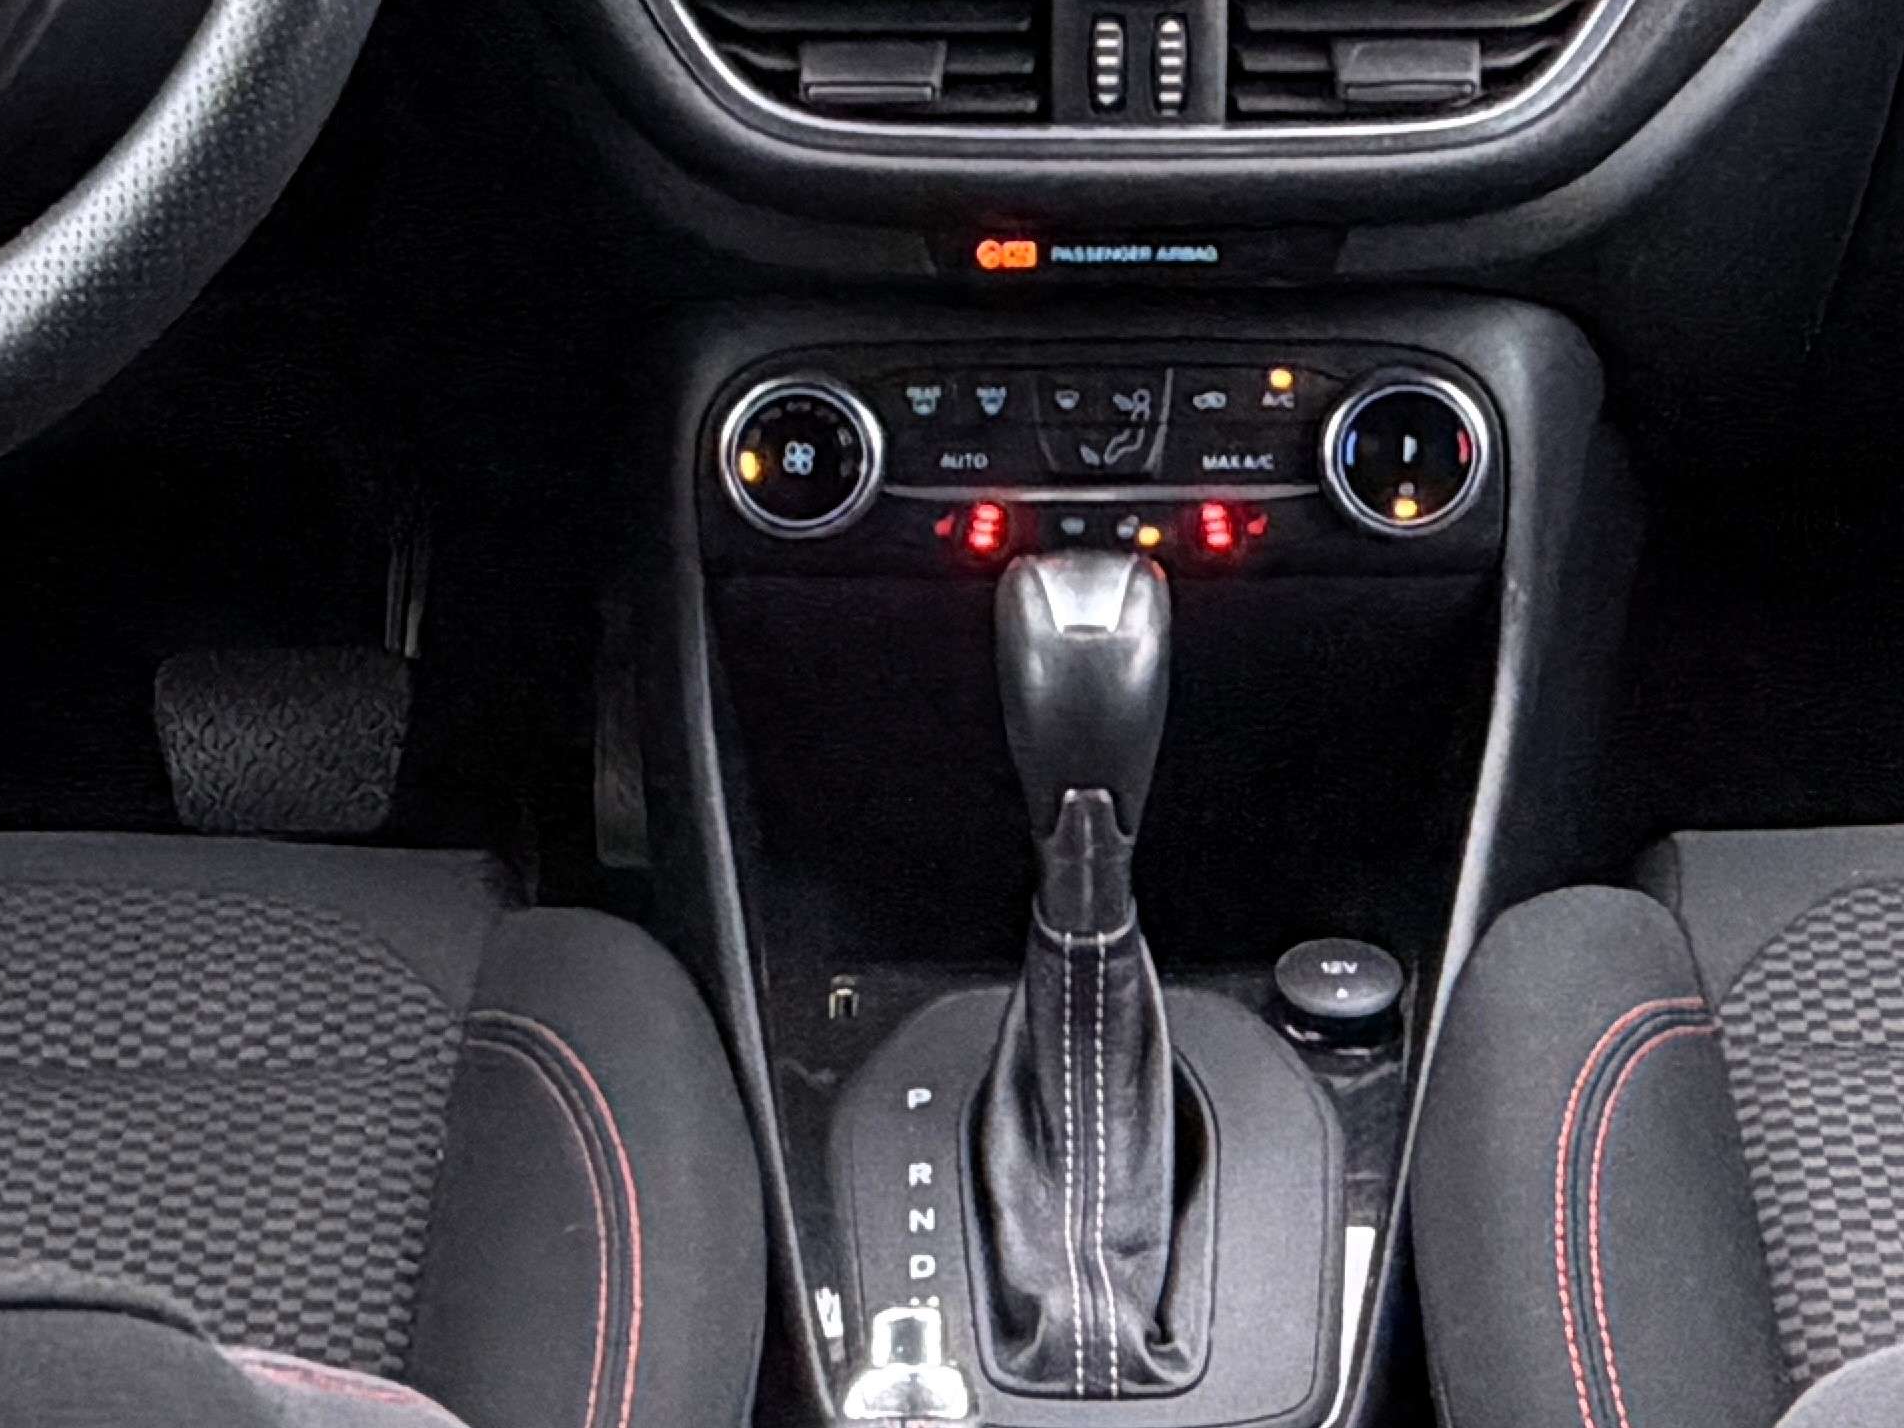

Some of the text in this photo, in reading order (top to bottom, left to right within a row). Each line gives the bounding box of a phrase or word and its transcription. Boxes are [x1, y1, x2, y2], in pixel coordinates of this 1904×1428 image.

[1050, 244, 1219, 264] PASSENGER AIRBAG
[1261, 391, 1296, 409] A/C
[939, 451, 990, 470] AUTO
[1202, 453, 1241, 470] MAX
[1320, 961, 1359, 975] 12V
[906, 1087, 933, 1110] P
[907, 1161, 933, 1187] R
[908, 1206, 937, 1234] N
[908, 1253, 937, 1280] D
